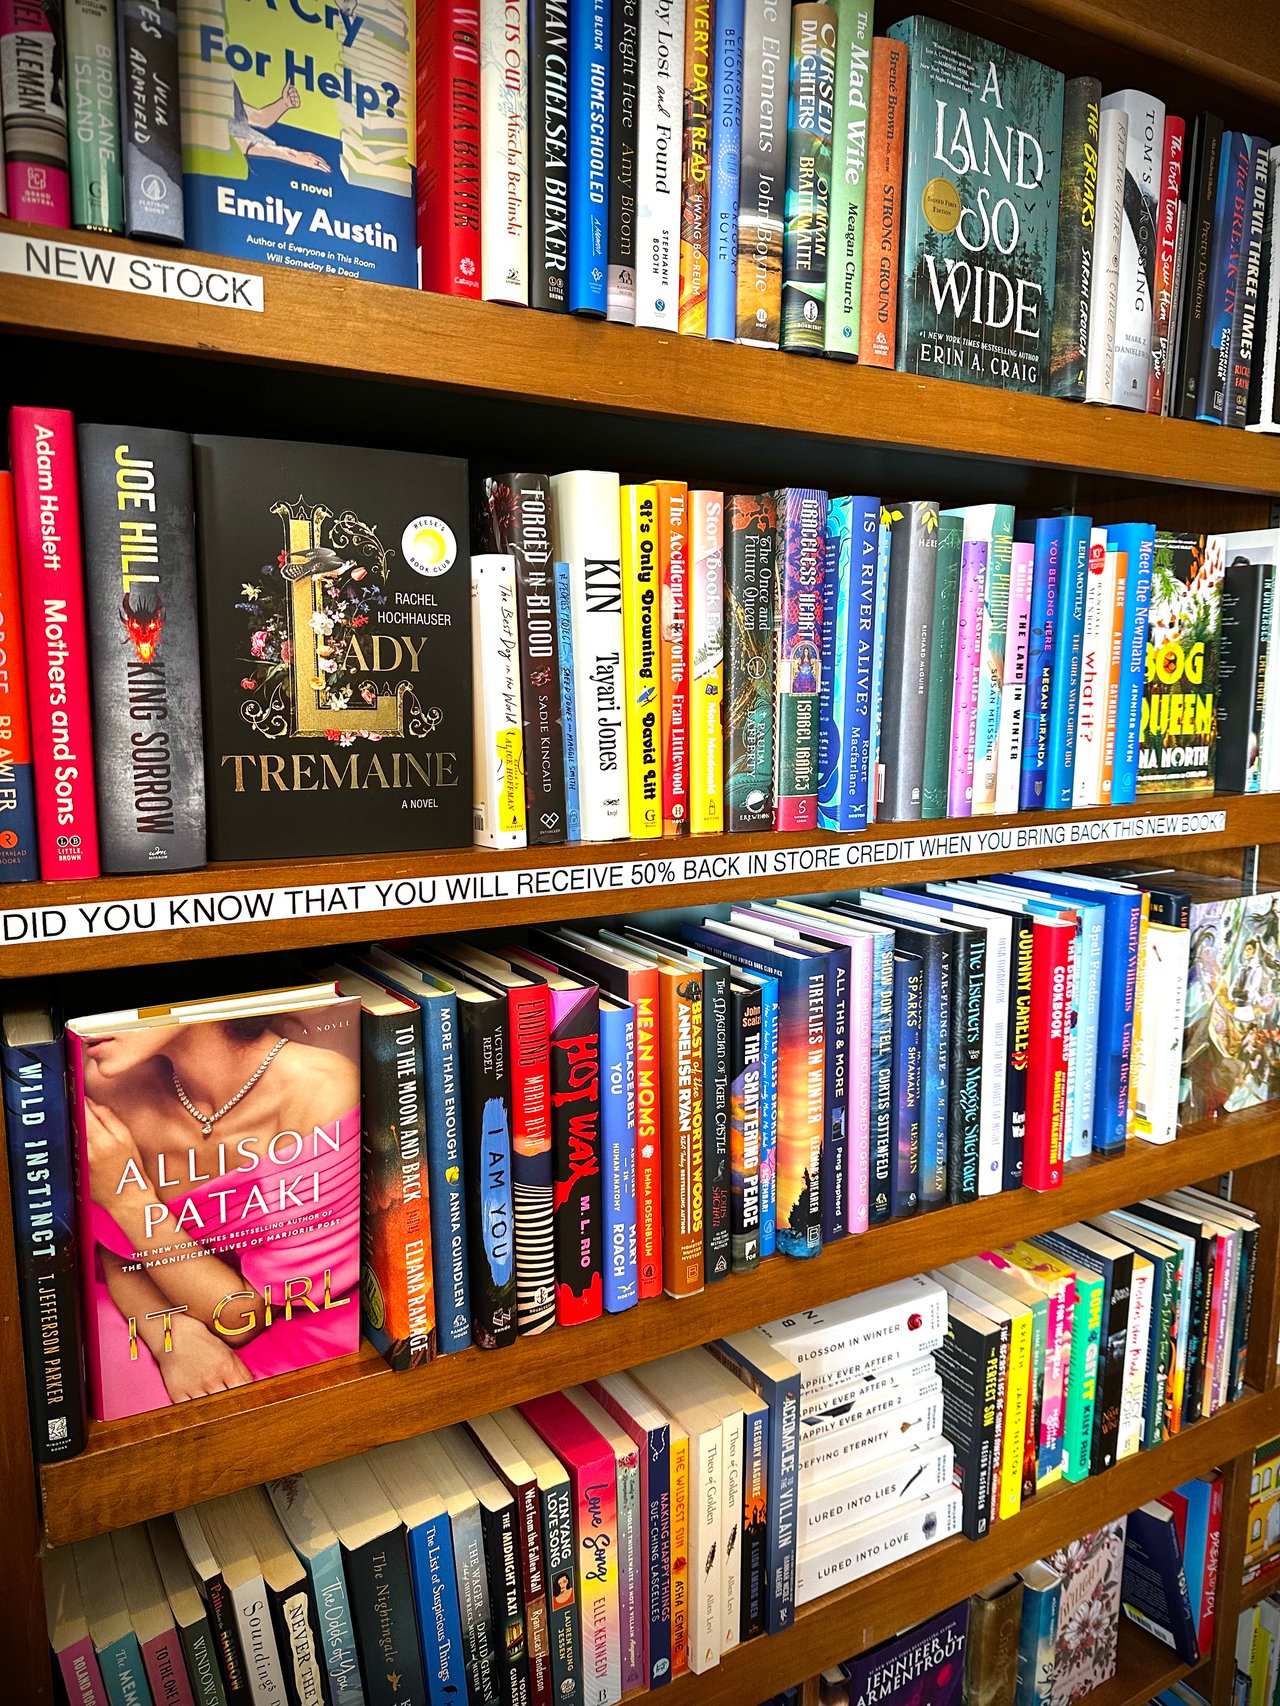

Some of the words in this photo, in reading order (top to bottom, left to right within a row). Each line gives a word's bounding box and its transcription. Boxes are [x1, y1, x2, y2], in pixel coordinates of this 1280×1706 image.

[856, 12, 868, 39] The
[75, 56, 94, 142] ISLAND
[131, 47, 150, 144] ARMFIELD
[152, 71, 168, 127] JULIA
[201, 24, 271, 77] For
[285, 49, 400, 118] Help?
[847, 42, 869, 114] Mad
[980, 60, 1004, 110] A
[96, 44, 115, 163] BIRDLANE
[545, 53, 568, 168] CHELSEA
[1087, 103, 1100, 132] THE
[590, 63, 606, 204] HOMESCHOOLED
[844, 121, 865, 185] Wife
[933, 100, 1044, 190] LAND
[290, 181, 298, 190] a
[301, 183, 333, 198] novel
[1081, 142, 1099, 233] BRIARS
[1254, 147, 1269, 185] THE
[217, 186, 302, 235] Emily
[309, 208, 398, 253] Austin
[545, 177, 568, 270] BIEKER
[881, 184, 896, 251] STRONG
[956, 186, 1019, 254] SO
[1248, 189, 1266, 236] DEVIL
[26, 244, 115, 284] NEW
[130, 261, 252, 306] STOCK
[246, 235, 276, 249] Author
[278, 241, 287, 250] of
[288, 243, 326, 260] Everyone
[327, 250, 336, 259] in
[337, 252, 353, 265] This
[355, 257, 377, 270] Room
[266, 253, 283, 266] Will
[285, 256, 323, 276] Someday
[325, 264, 336, 275] Be
[338, 268, 359, 280] Dead
[1079, 247, 1092, 295] SARAH
[1244, 240, 1262, 298] THREE
[877, 257, 892, 323] GROUND
[923, 255, 1042, 338] WIDE
[1078, 300, 1089, 357] CROUCH
[1239, 303, 1256, 361] TIMES
[920, 343, 963, 369] ERIN
[972, 353, 985, 372] A.
[991, 357, 1037, 384] CRAIG
[34, 424, 54, 491] Adam
[114, 445, 156, 512] JOE
[40, 495, 62, 571] Haslett
[521, 488, 547, 562] FORGED
[639, 500, 654, 533] It's
[863, 512, 877, 534] IS
[119, 521, 160, 594] HILL
[638, 540, 654, 582] Only
[863, 541, 876, 555] A
[395, 592, 437, 607] RACHEL
[529, 571, 549, 586] IN
[585, 557, 622, 614] KIN
[859, 564, 874, 631] RIVER
[377, 612, 452, 627] HOCHHAUSER
[526, 595, 553, 658] BLOOD
[639, 589, 656, 678] Drowning
[43, 599, 73, 706] Mothers
[855, 642, 870, 716] ALIVE?
[126, 661, 167, 721] KING
[588, 652, 620, 711] Tayari
[1040, 667, 1051, 709] MEGAN
[50, 710, 76, 760] and
[539, 696, 551, 732] SADIE
[641, 712, 656, 764] David
[1037, 714, 1048, 768] MIRANDA
[541, 737, 554, 793] KINCAID
[597, 717, 622, 770] Jones
[54, 766, 79, 824] Sons
[131, 732, 174, 835] SORROW
[221, 752, 459, 793] TREMAINE
[642, 770, 657, 800] Litt
[402, 800, 409, 809] A
[410, 799, 438, 810] NOVEL
[3, 911, 66, 941] DID
[79, 902, 156, 934] YOU
[170, 893, 275, 925] KNOW
[285, 884, 365, 916] THAT
[376, 880, 436, 907] YOU
[446, 875, 508, 901] WILL
[518, 867, 624, 895] RECEIVE
[631, 863, 676, 886] 50%
[684, 855, 740, 880] BACK
[749, 855, 766, 873] IN
[774, 847, 840, 870] STORE
[847, 841, 913, 864] CREDIT
[920, 834, 971, 857] WHEN
[978, 832, 1012, 850] YOU
[1018, 826, 1066, 846] BRING
[1071, 823, 1108, 842] BACK
[1113, 819, 1145, 837] THIS
[1148, 817, 1176, 834] NEW
[1182, 813, 1226, 832] BOOK?
[395, 1025, 415, 1045] TO
[440, 1008, 453, 1051] MORE
[638, 998, 654, 1062] MEAN
[808, 975, 825, 1044] FIREFLIES
[397, 1048, 416, 1078] THE
[442, 1055, 455, 1097] THAN
[551, 1033, 599, 1107] HOT
[743, 1032, 760, 1065] THE
[808, 1050, 824, 1064] IN
[19, 1063, 45, 1126] WILD
[399, 1082, 418, 1126] MOON
[638, 1070, 654, 1137] MOMS
[743, 1072, 760, 1169] SHATTERING
[807, 1070, 823, 1124] WINTER
[116, 1120, 341, 1196] ALLISON
[401, 1130, 419, 1160] AND
[443, 1101, 458, 1160] ENOUGH
[401, 1163, 422, 1204] BACK
[555, 1111, 600, 1213] WAX
[644, 1168, 652, 1197] EMMA
[24, 1140, 55, 1257] INSTINCT
[145, 1171, 319, 1239] PATAKI
[448, 1192, 461, 1232] ANNA
[580, 1196, 590, 1214] M.
[743, 1177, 759, 1229] PEACE
[580, 1220, 591, 1235] L.
[580, 1240, 591, 1267] RIO
[644, 1200, 653, 1257] ROSENBLUM
[450, 1236, 465, 1307] QUINDLEN
[128, 1305, 188, 1362] IT
[213, 1268, 350, 1337] GIRL
[798, 1342, 846, 1364] BLOSSOM
[849, 1336, 860, 1347] IN
[862, 1324, 901, 1342] WINTER
[675, 1449, 685, 1471] THE
[781, 1399, 797, 1475] ACCOMPLICE
[584, 1483, 608, 1528] Love
[675, 1475, 686, 1524] WILDEST
[778, 1488, 794, 1549] VILLAIN
[809, 1505, 844, 1526] LURED
[847, 1494, 873, 1511] INTO
[875, 1484, 898, 1499] LIES
[371, 1552, 388, 1579] The
[582, 1534, 610, 1582] Song
[675, 1528, 685, 1548] SUN
[818, 1558, 852, 1580] LURED
[856, 1545, 881, 1563] INTO
[884, 1532, 910, 1550] LOVE
[242, 1600, 279, 1693] Soundings
[374, 1584, 397, 1665] Nightingale
[856, 1633, 967, 1705] ARMENTROUT
[866, 1635, 944, 1695] JENNIFER
[945, 1628, 957, 1644] L.
